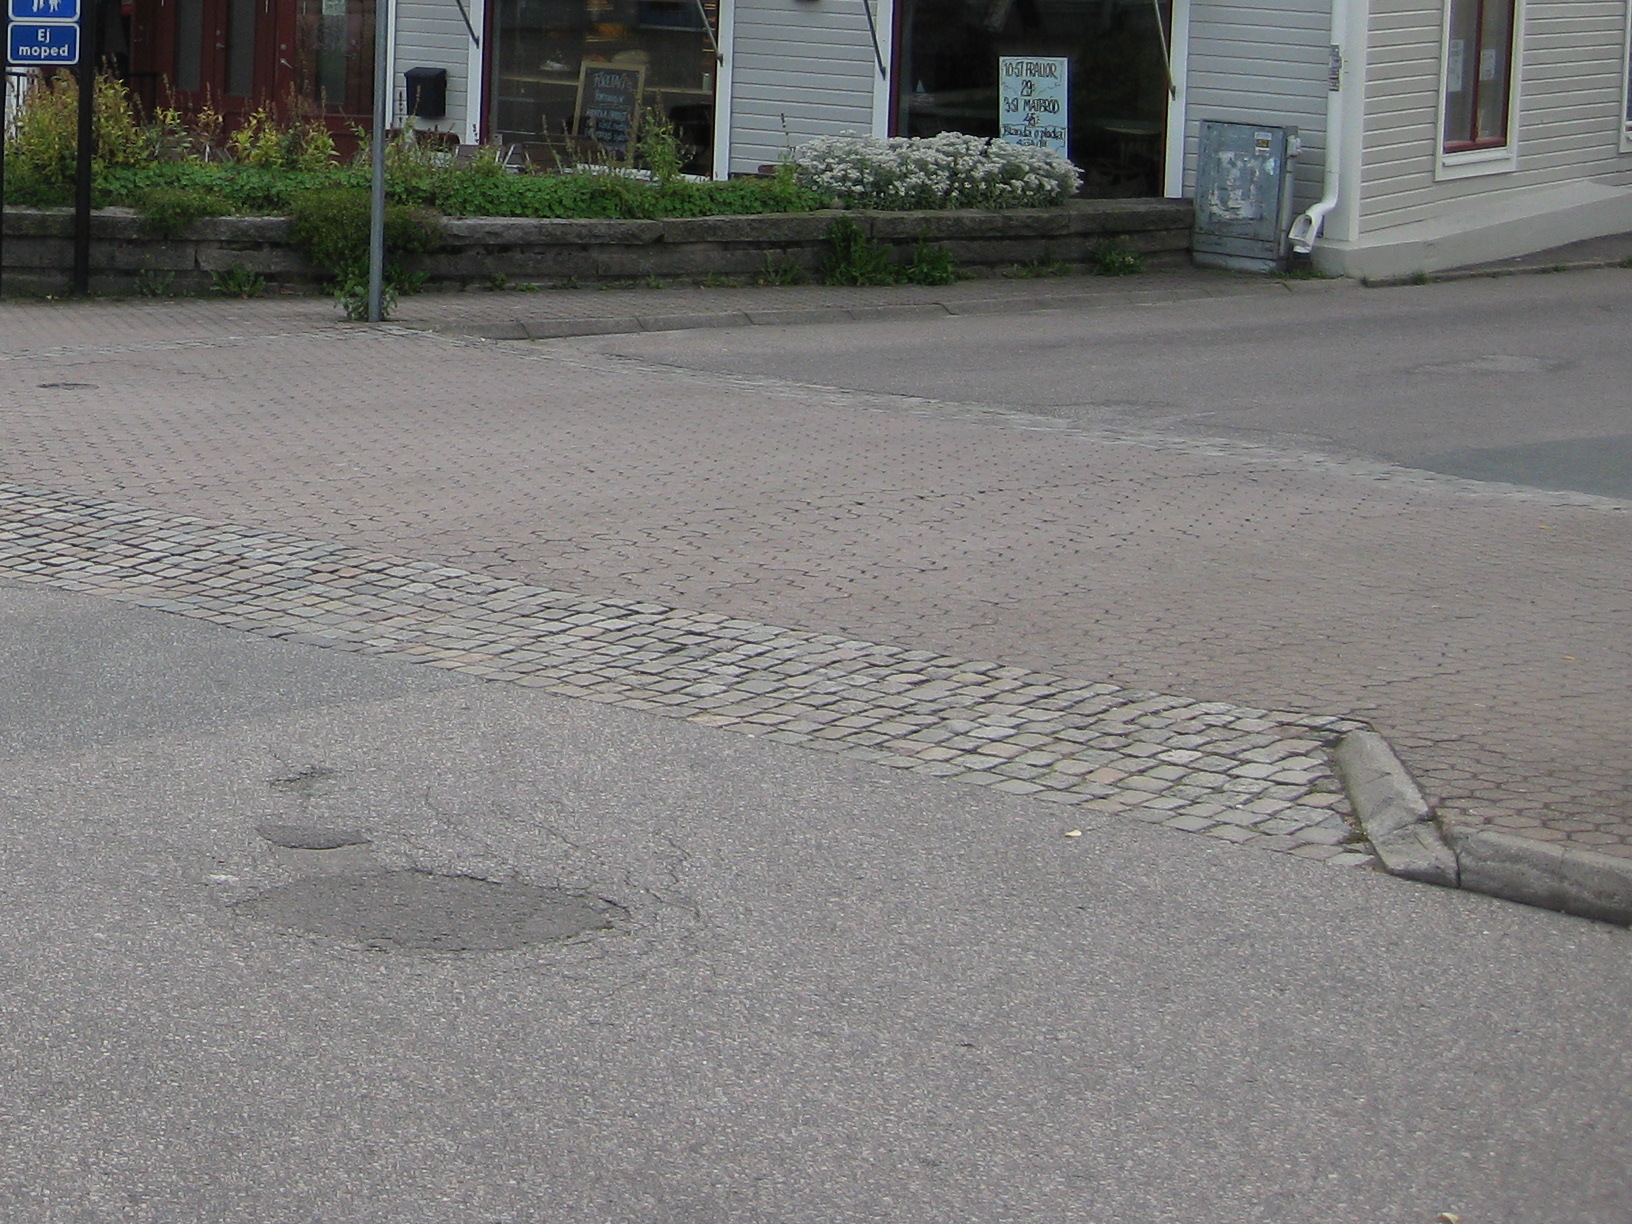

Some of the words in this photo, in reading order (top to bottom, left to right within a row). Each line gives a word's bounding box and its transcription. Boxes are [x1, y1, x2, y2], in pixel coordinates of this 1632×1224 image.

[37, 28, 50, 43] Ej
[18, 44, 69, 59] moped
[1025, 61, 1058, 80] FRALLOR
